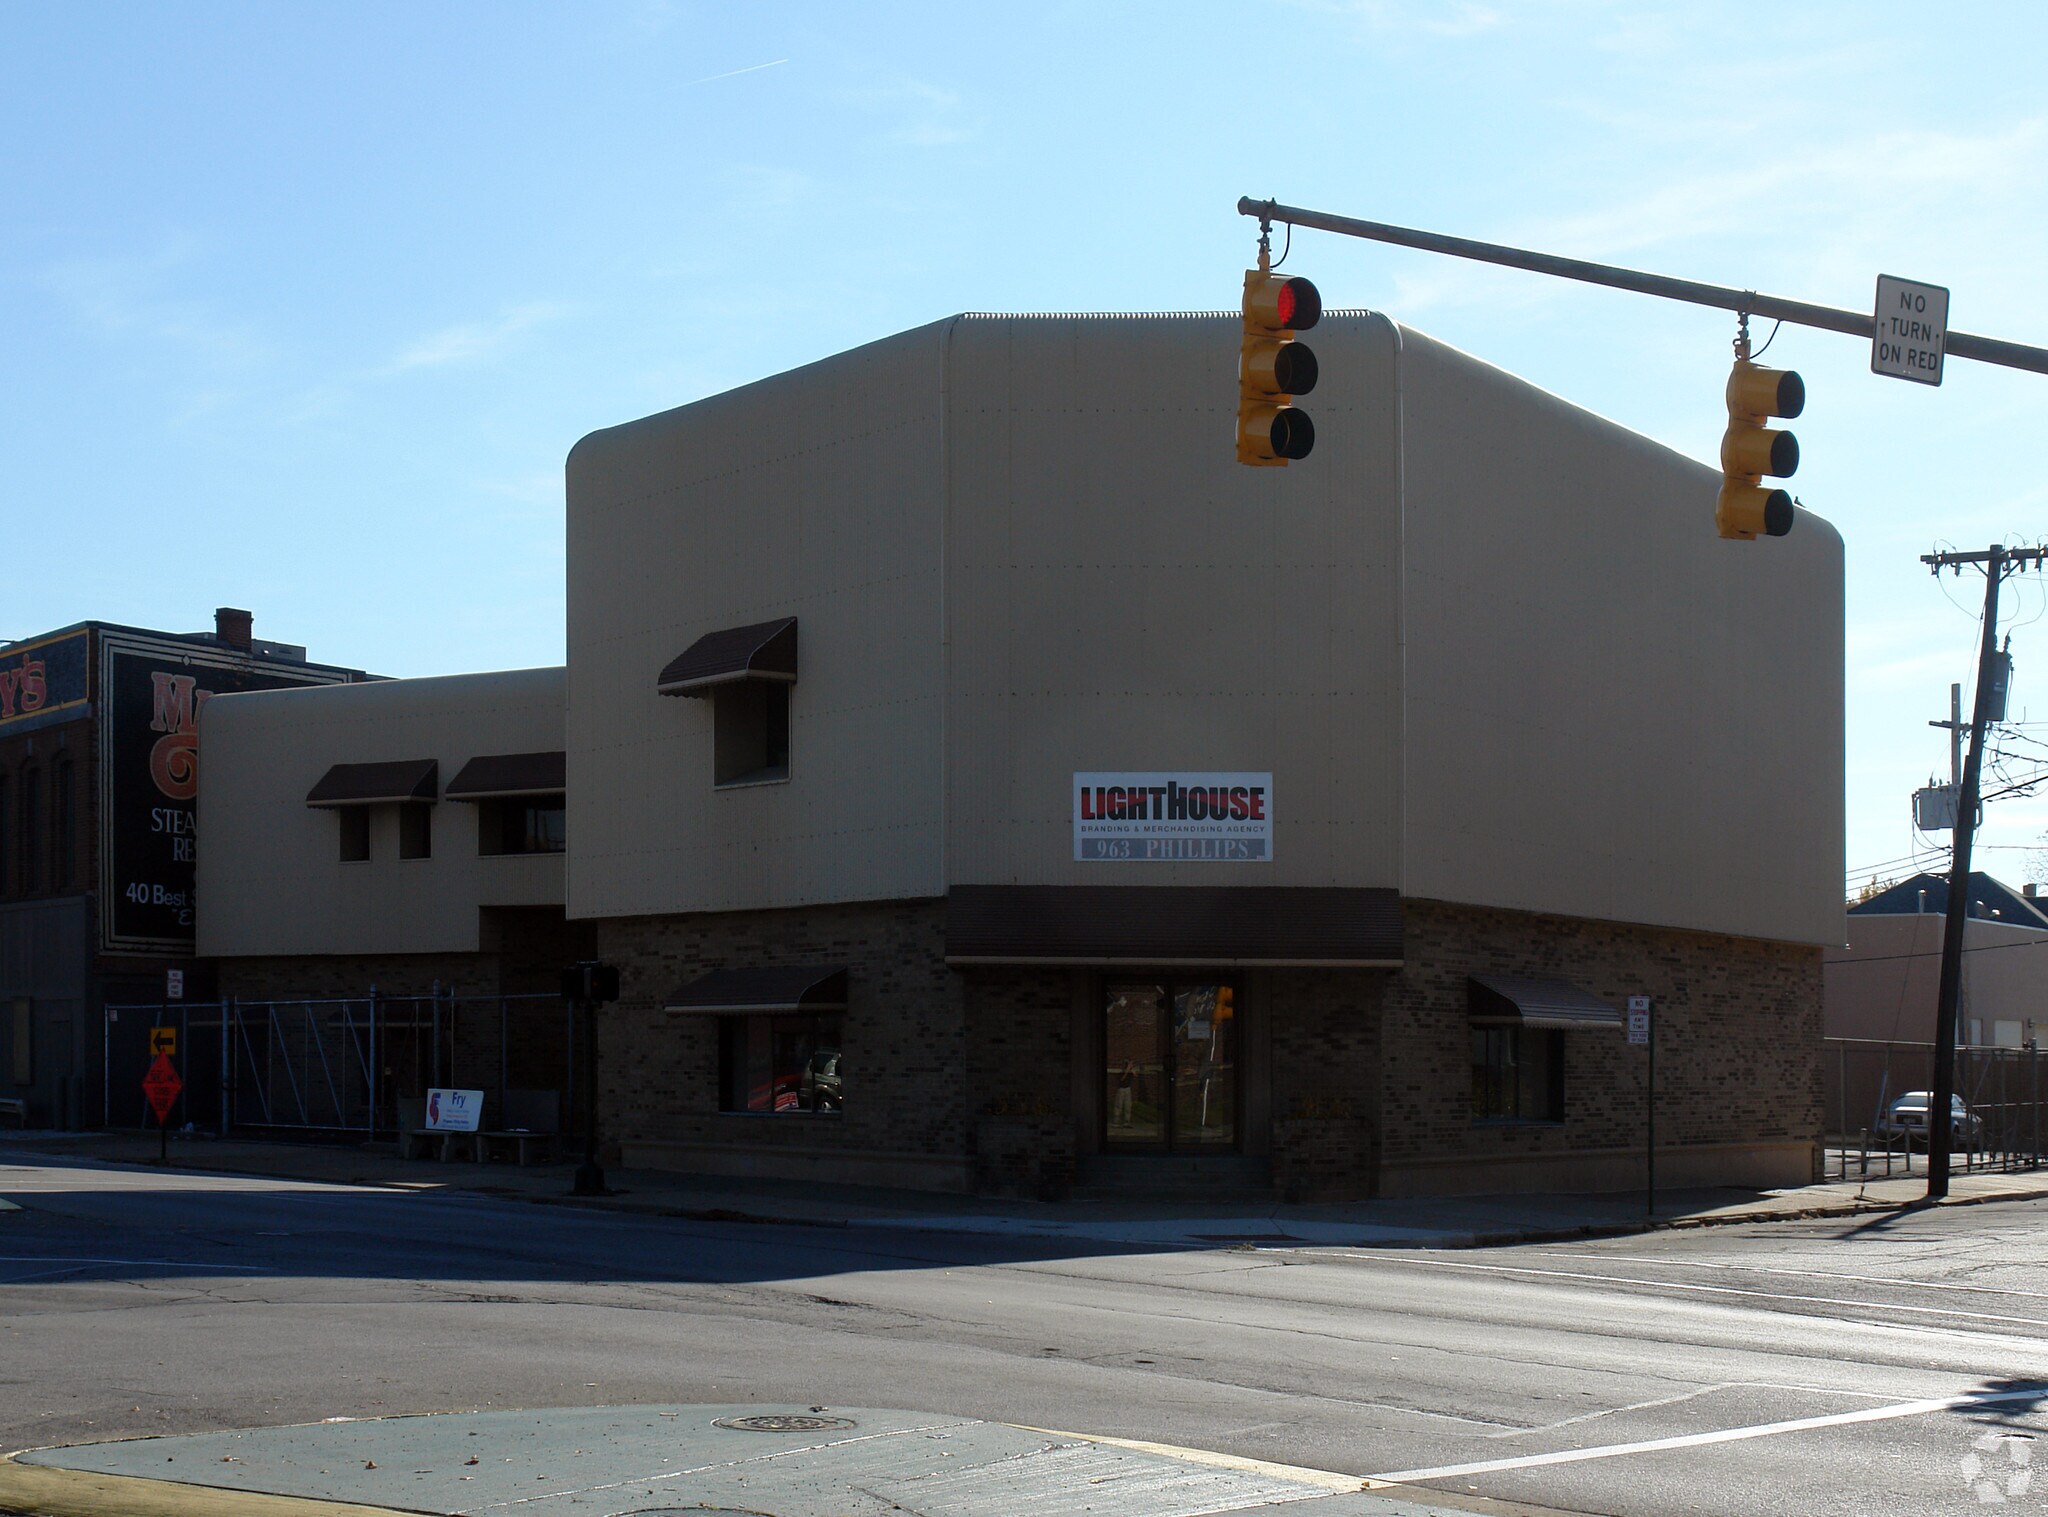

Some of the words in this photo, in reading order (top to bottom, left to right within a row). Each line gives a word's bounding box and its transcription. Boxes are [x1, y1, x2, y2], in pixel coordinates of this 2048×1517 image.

[1900, 291, 1926, 313] NO
[1891, 317, 1932, 342] TURN
[1880, 343, 1901, 364] ON
[1907, 348, 1938, 371] RED
[1081, 781, 1265, 821] LIGHTHOUSE
[1081, 825, 1130, 833] BRANDING
[1134, 825, 1140, 833] &
[1144, 825, 1223, 833] MERCHANDISING
[1227, 825, 1266, 833] AGENCY
[172, 836, 197, 862] RE
[1097, 840, 1131, 859] 963
[1146, 839, 1250, 859] PHILLIPS
[126, 882, 149, 904] 40
[152, 884, 187, 907] Best
[452, 1092, 467, 1108] Fry
